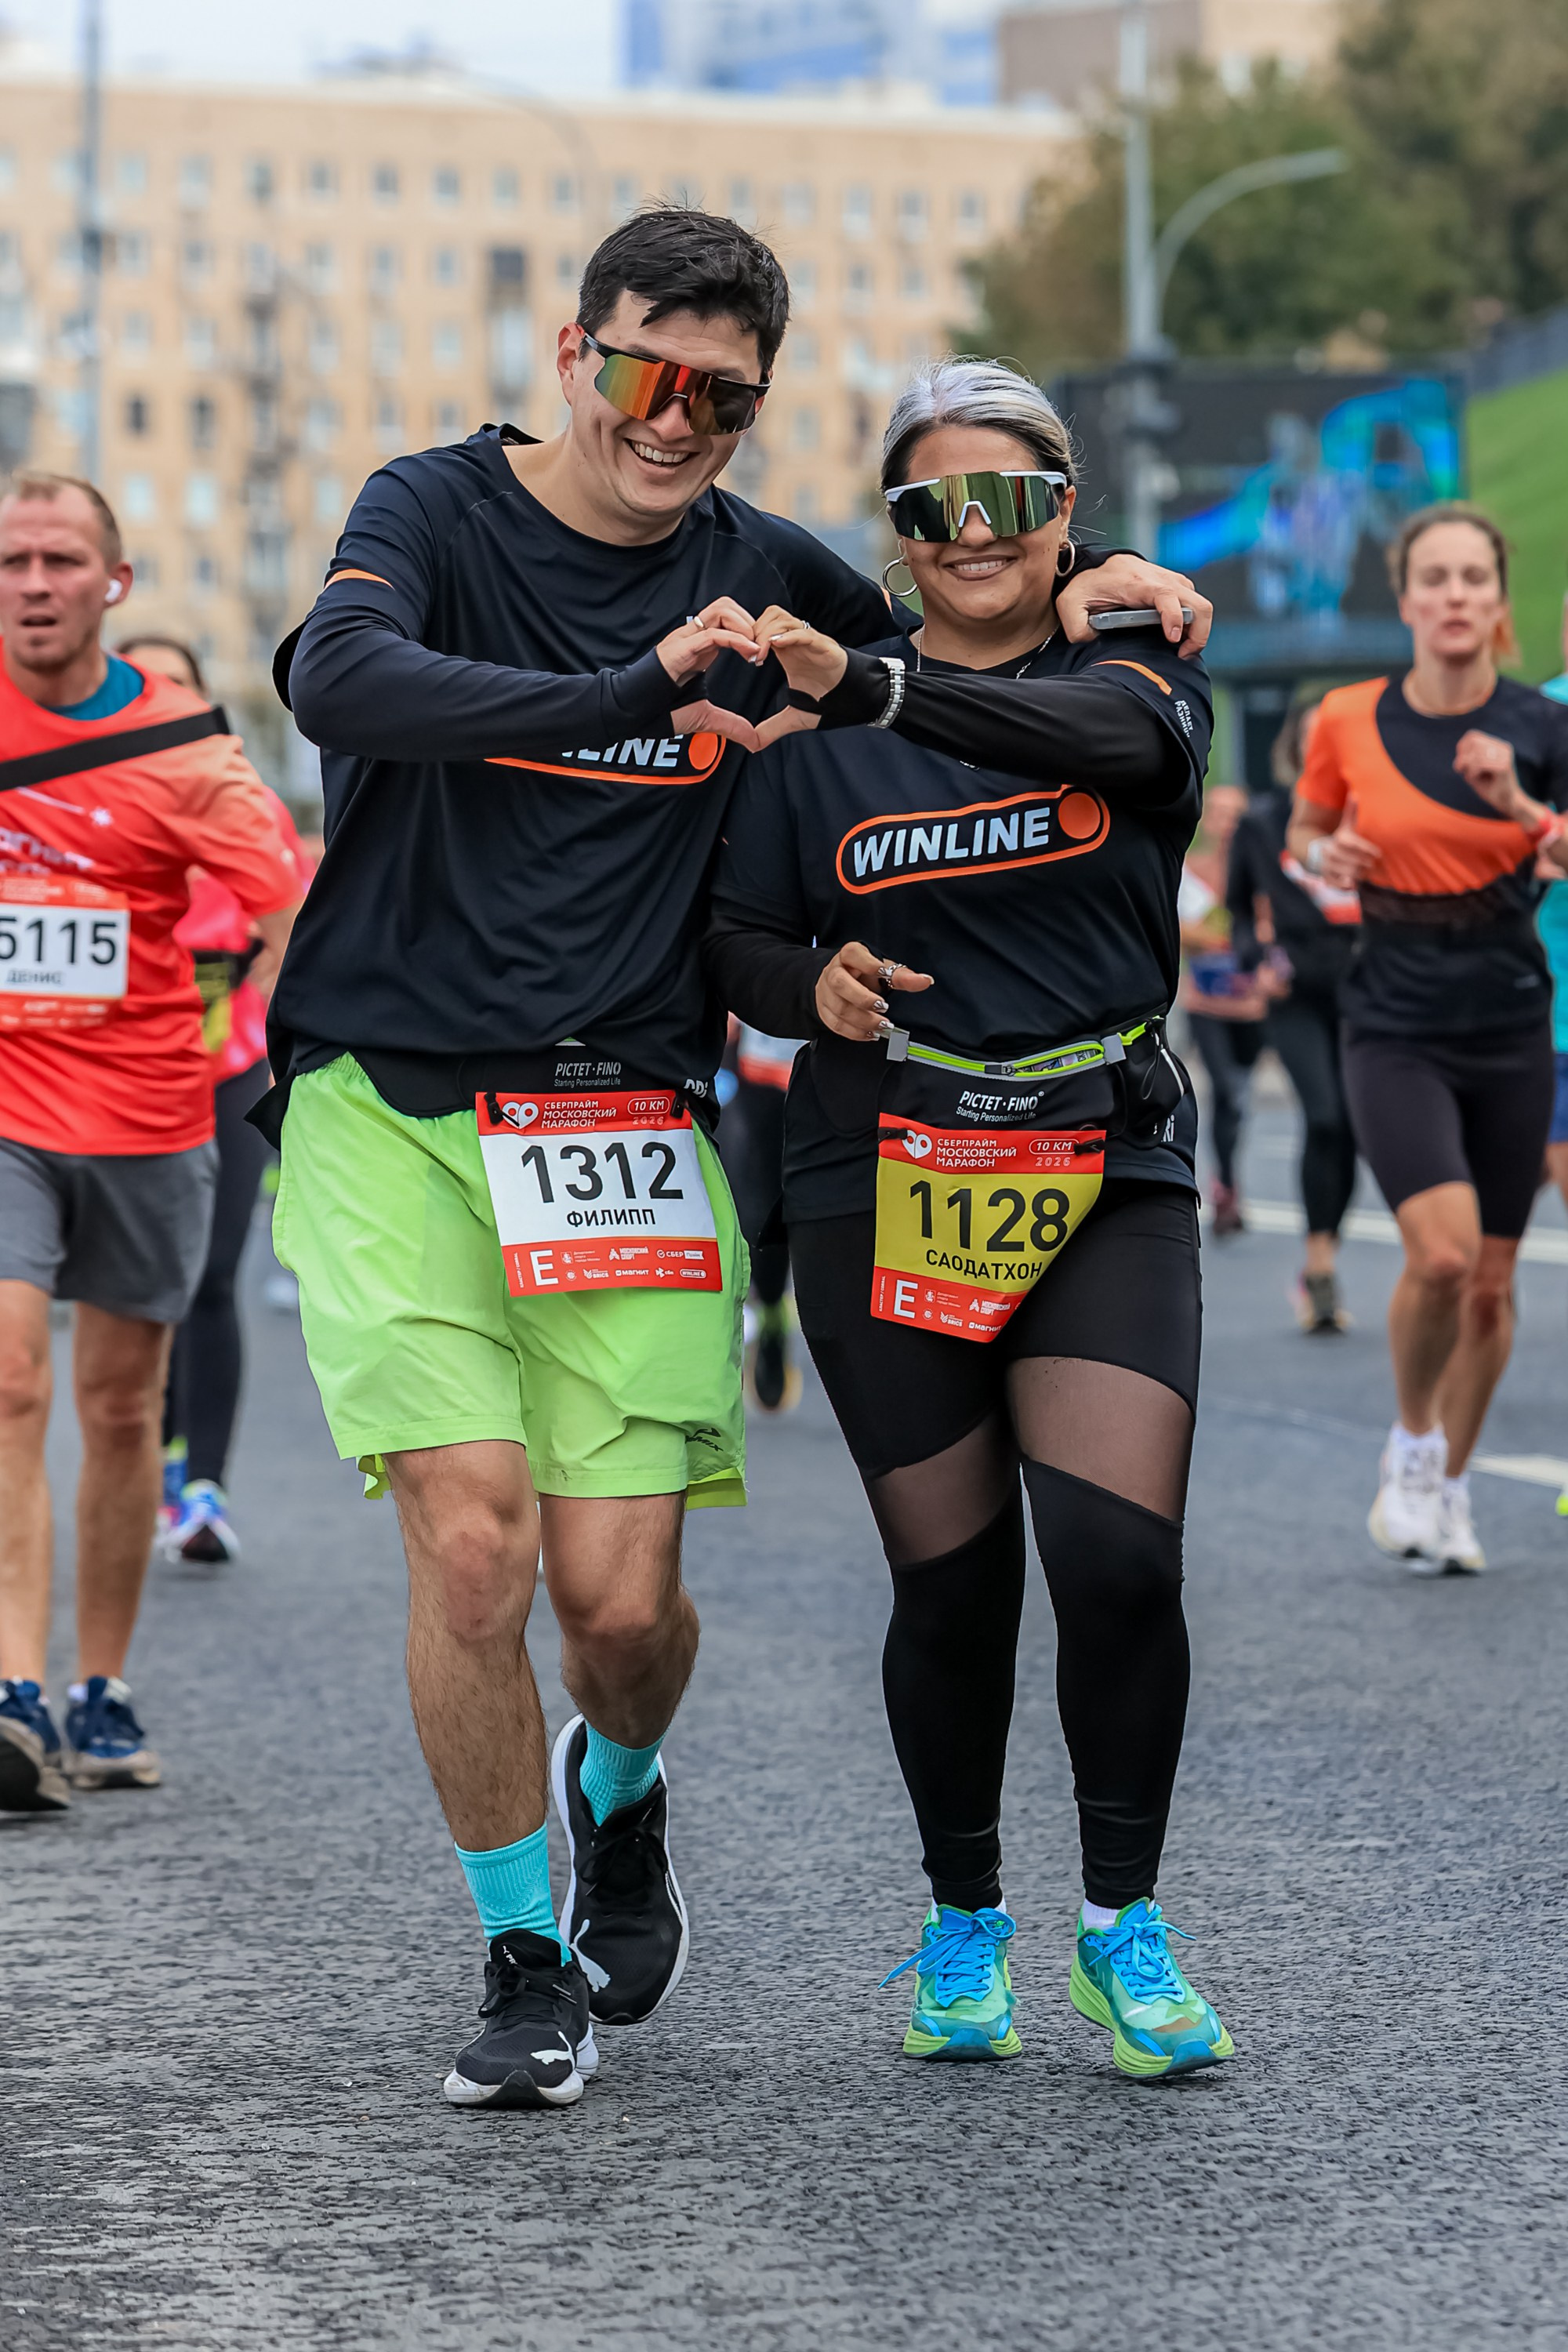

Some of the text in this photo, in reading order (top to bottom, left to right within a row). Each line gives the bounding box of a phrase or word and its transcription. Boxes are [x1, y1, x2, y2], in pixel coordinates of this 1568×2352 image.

[854, 808, 1051, 878] WINLINE
[0, 916, 117, 965] 5115
[554, 1077, 621, 1088] Starting Personalized Life
[544, 1100, 598, 1109] СБЕРПРАЙМ
[633, 1102, 646, 1112] 10
[543, 1107, 617, 1120] МОСКОВСКИЙ
[956, 1106, 1036, 1123] Starting Personalized Life
[541, 1119, 596, 1129] МАРАФОН
[632, 1116, 664, 1125] 2026
[937, 1138, 996, 1147] СБЕРПРАЙМ
[1036, 1142, 1050, 1151] 10
[936, 1146, 1017, 1157] МОСКОВСКИЙ
[936, 1157, 996, 1167] МАРАФОН
[1035, 1157, 1071, 1167] 2026
[521, 1142, 684, 1203] 1312
[566, 1209, 656, 1228] ФИЛИПП
[909, 1179, 1070, 1252] 1128
[926, 1248, 1043, 1280] САОДАТХОН
